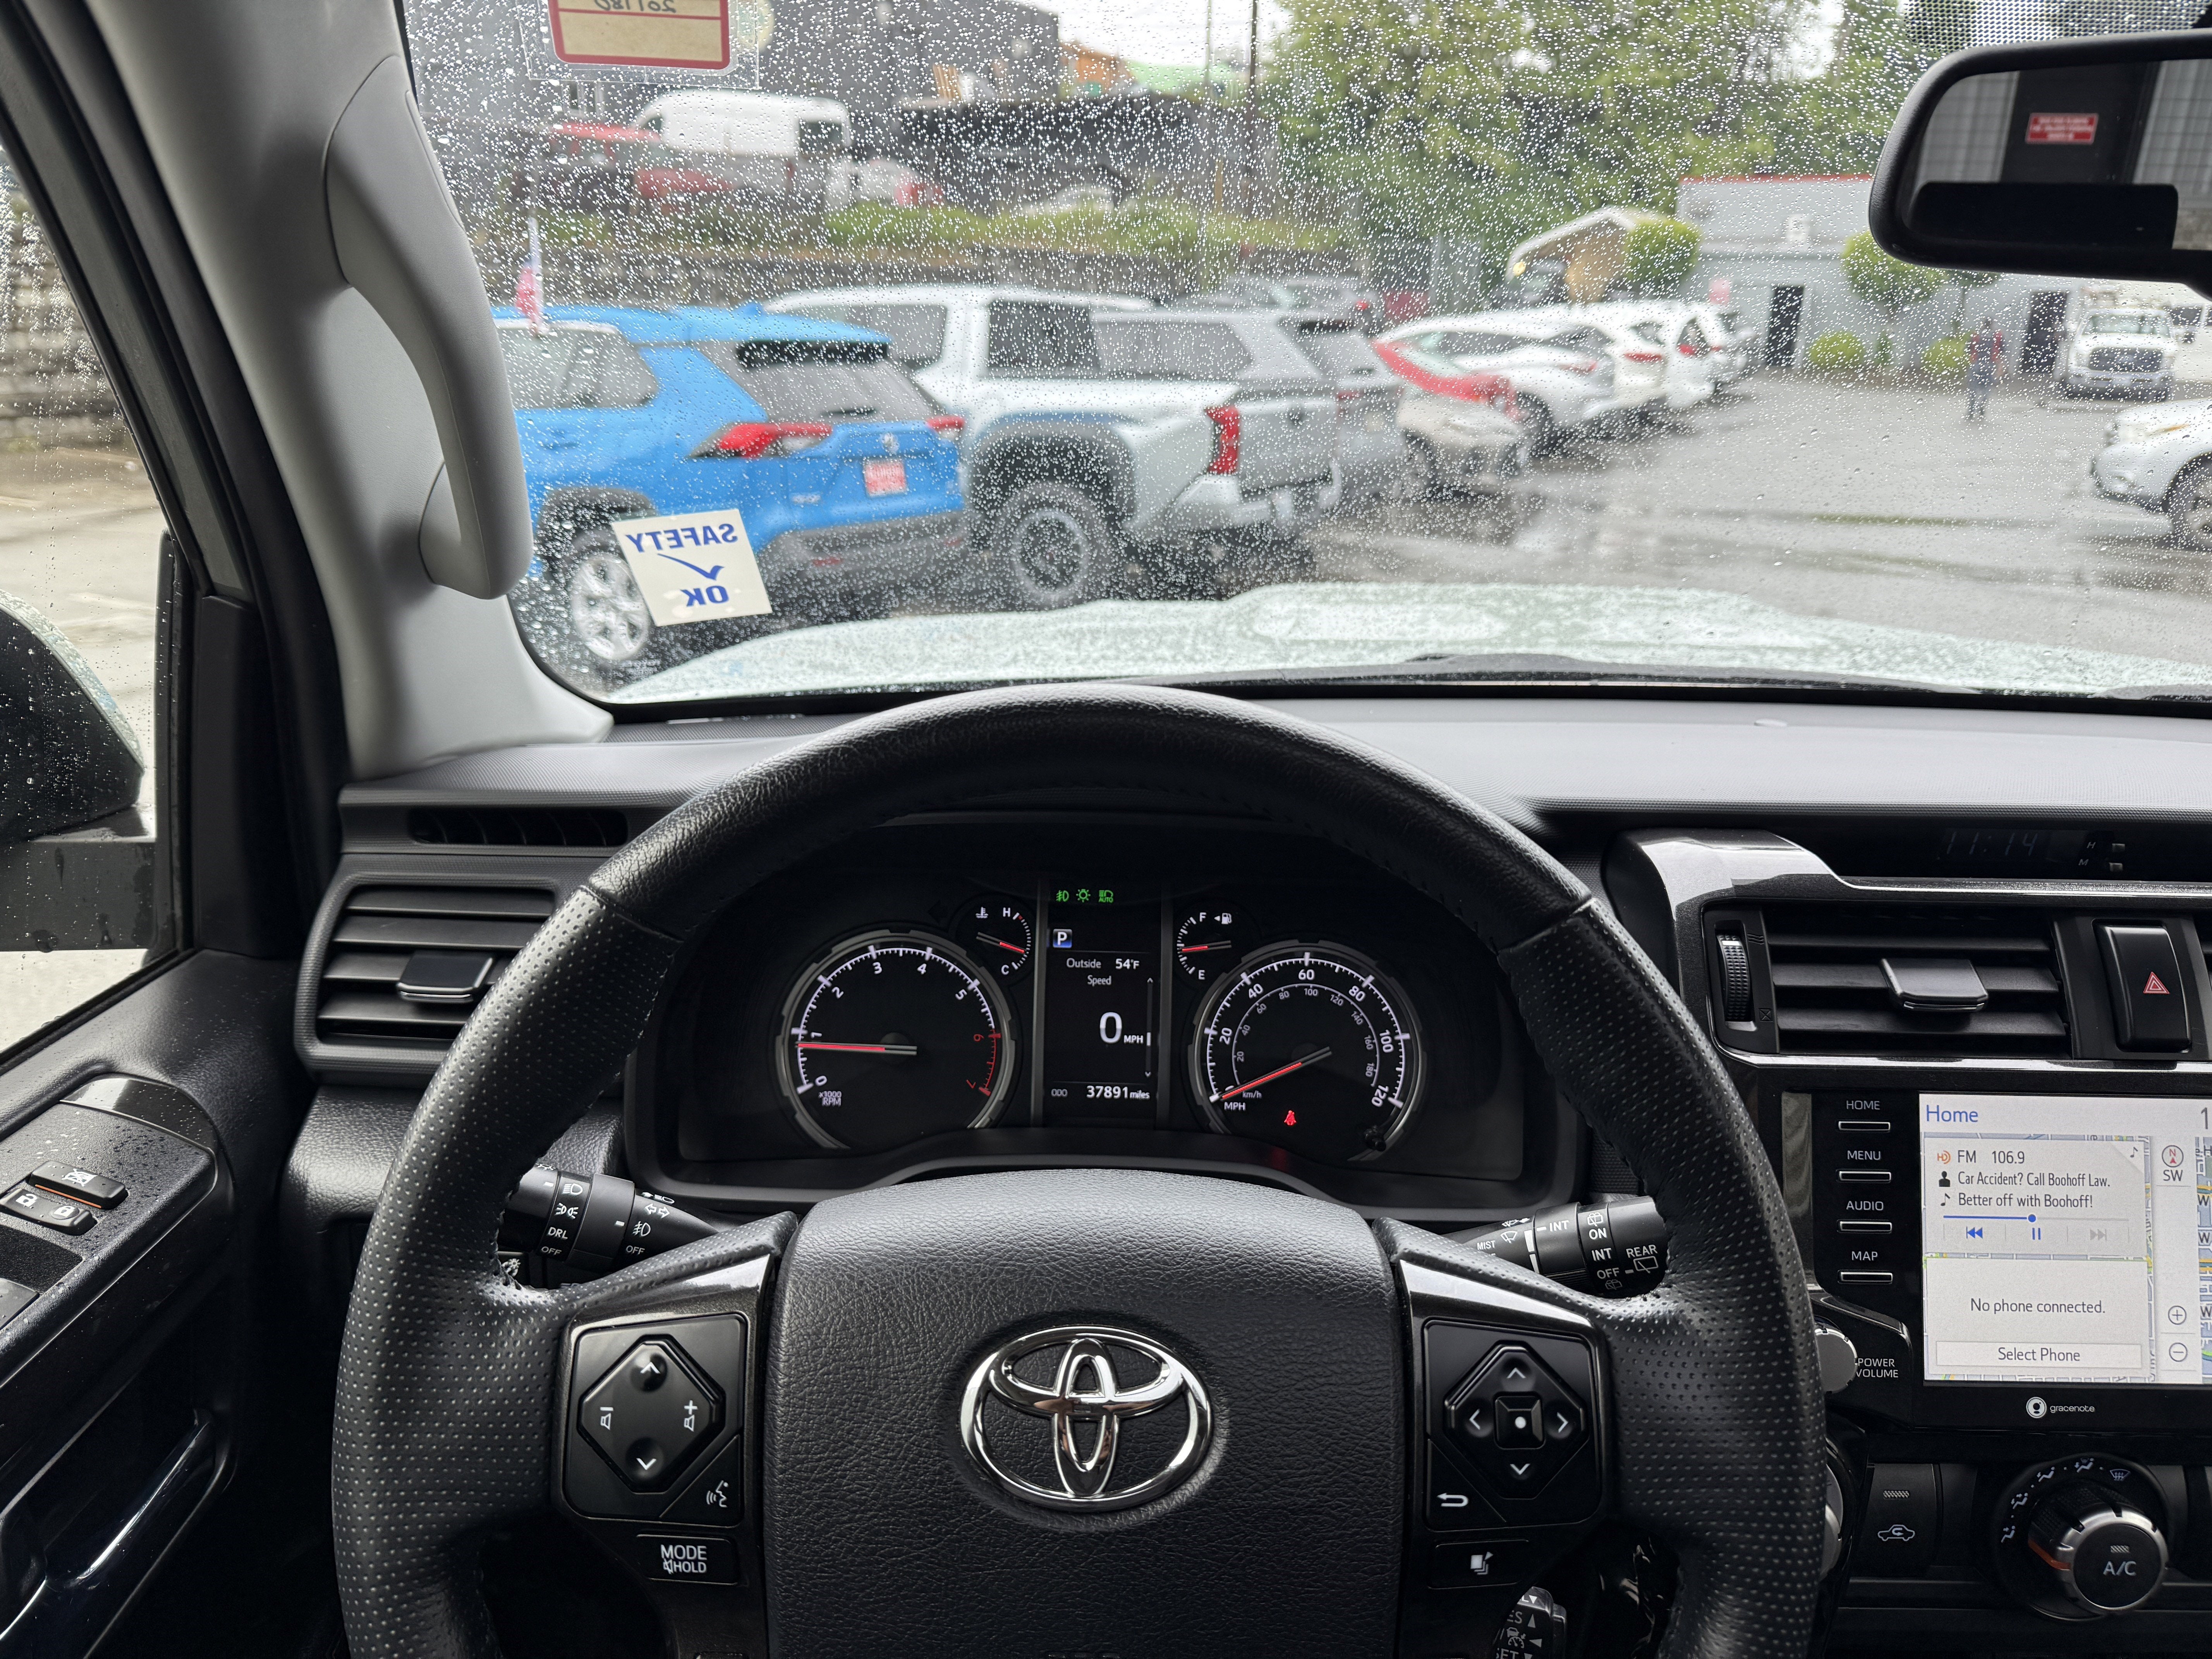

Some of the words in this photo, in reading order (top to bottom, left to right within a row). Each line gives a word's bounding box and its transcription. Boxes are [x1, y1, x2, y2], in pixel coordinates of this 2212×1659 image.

[1946, 831, 2038, 856] 11:14
[1003, 908, 1011, 917] H
[1199, 912, 1207, 922] F
[1057, 931, 1067, 945] P
[872, 962, 883, 974] 3
[917, 963, 926, 974] 4
[1066, 958, 1102, 968] Outside
[1001, 964, 1009, 975] C
[1198, 970, 1206, 980] E
[1298, 969, 1315, 981] 60
[1087, 975, 1112, 987] Speed
[831, 986, 844, 998] 2
[955, 989, 967, 1000] 5
[1248, 984, 1264, 999] 40
[1278, 990, 1290, 1000] 80
[1304, 988, 1318, 996] 100
[1348, 986, 1366, 1002] 80
[1330, 994, 1344, 1006] 120
[1257, 1003, 1267, 1015] 60
[1351, 1011, 1364, 1025] 140
[1099, 1012, 1122, 1044] 0
[1123, 1035, 1144, 1044] MPH
[1241, 1025, 1251, 1036] 40
[973, 1034, 984, 1042] 6
[1219, 1027, 1233, 1045] 20
[1379, 1029, 1394, 1053] 100
[1364, 1035, 1374, 1050] 160
[1237, 1051, 1245, 1063] 20
[1365, 1062, 1375, 1077] 180
[815, 1075, 828, 1086] 0
[966, 1079, 976, 1089] 7
[1051, 1089, 1068, 1097] ODO
[1086, 1085, 1128, 1099] 37891
[1129, 1090, 1150, 1099] miles
[1242, 1090, 1262, 1099] km/h
[1371, 1085, 1389, 1108] 120
[822, 1097, 842, 1106] RPM
[1224, 1102, 1246, 1111] MPH
[1846, 1100, 1881, 1110] HOME
[1926, 1104, 1978, 1122] Home
[1847, 1150, 1881, 1161] MENU
[1958, 1150, 1977, 1163] FM
[1992, 1150, 2025, 1164] 106.9
[2169, 1148, 2176, 1157] N
[1958, 1171, 1974, 1184] Car
[1977, 1171, 2023, 1185] Accident?
[2027, 1172, 2045, 1186] Call
[2048, 1173, 2086, 1187] Boohoff
[2088, 1173, 2111, 1187] Law.
[2162, 1170, 2183, 1182] SW
[1846, 1200, 1884, 1211] AUDIO
[1958, 1192, 1993, 1206] Better
[1996, 1193, 2013, 1206] off
[2017, 1194, 2041, 1207] with
[2044, 1194, 2093, 1208] Boohoff!
[1549, 1219, 1569, 1232] INT
[547, 1226, 568, 1240] DRL
[1588, 1227, 1607, 1240] ON
[541, 1245, 562, 1256] OFF
[625, 1245, 646, 1255] OFF
[1477, 1240, 1496, 1250] MIST
[1591, 1248, 1612, 1262] INT
[1626, 1244, 1658, 1259] REAR
[1851, 1251, 1878, 1261] MAP
[1596, 1267, 1620, 1280] OFF
[1970, 1298, 1990, 1312] No
[1994, 1298, 2033, 1314] phone
[2037, 1300, 2106, 1314] connected.
[1998, 1347, 2037, 1361] Select
[2040, 1348, 2080, 1362] Phone
[1857, 1358, 1895, 1367] POWER
[1856, 1369, 1899, 1378] VOLUME
[2050, 1405, 2095, 1413] gracenote
[660, 1544, 708, 1560] MODE
[673, 1561, 707, 1573] HOLD
[2102, 1560, 2137, 1577] A/C
